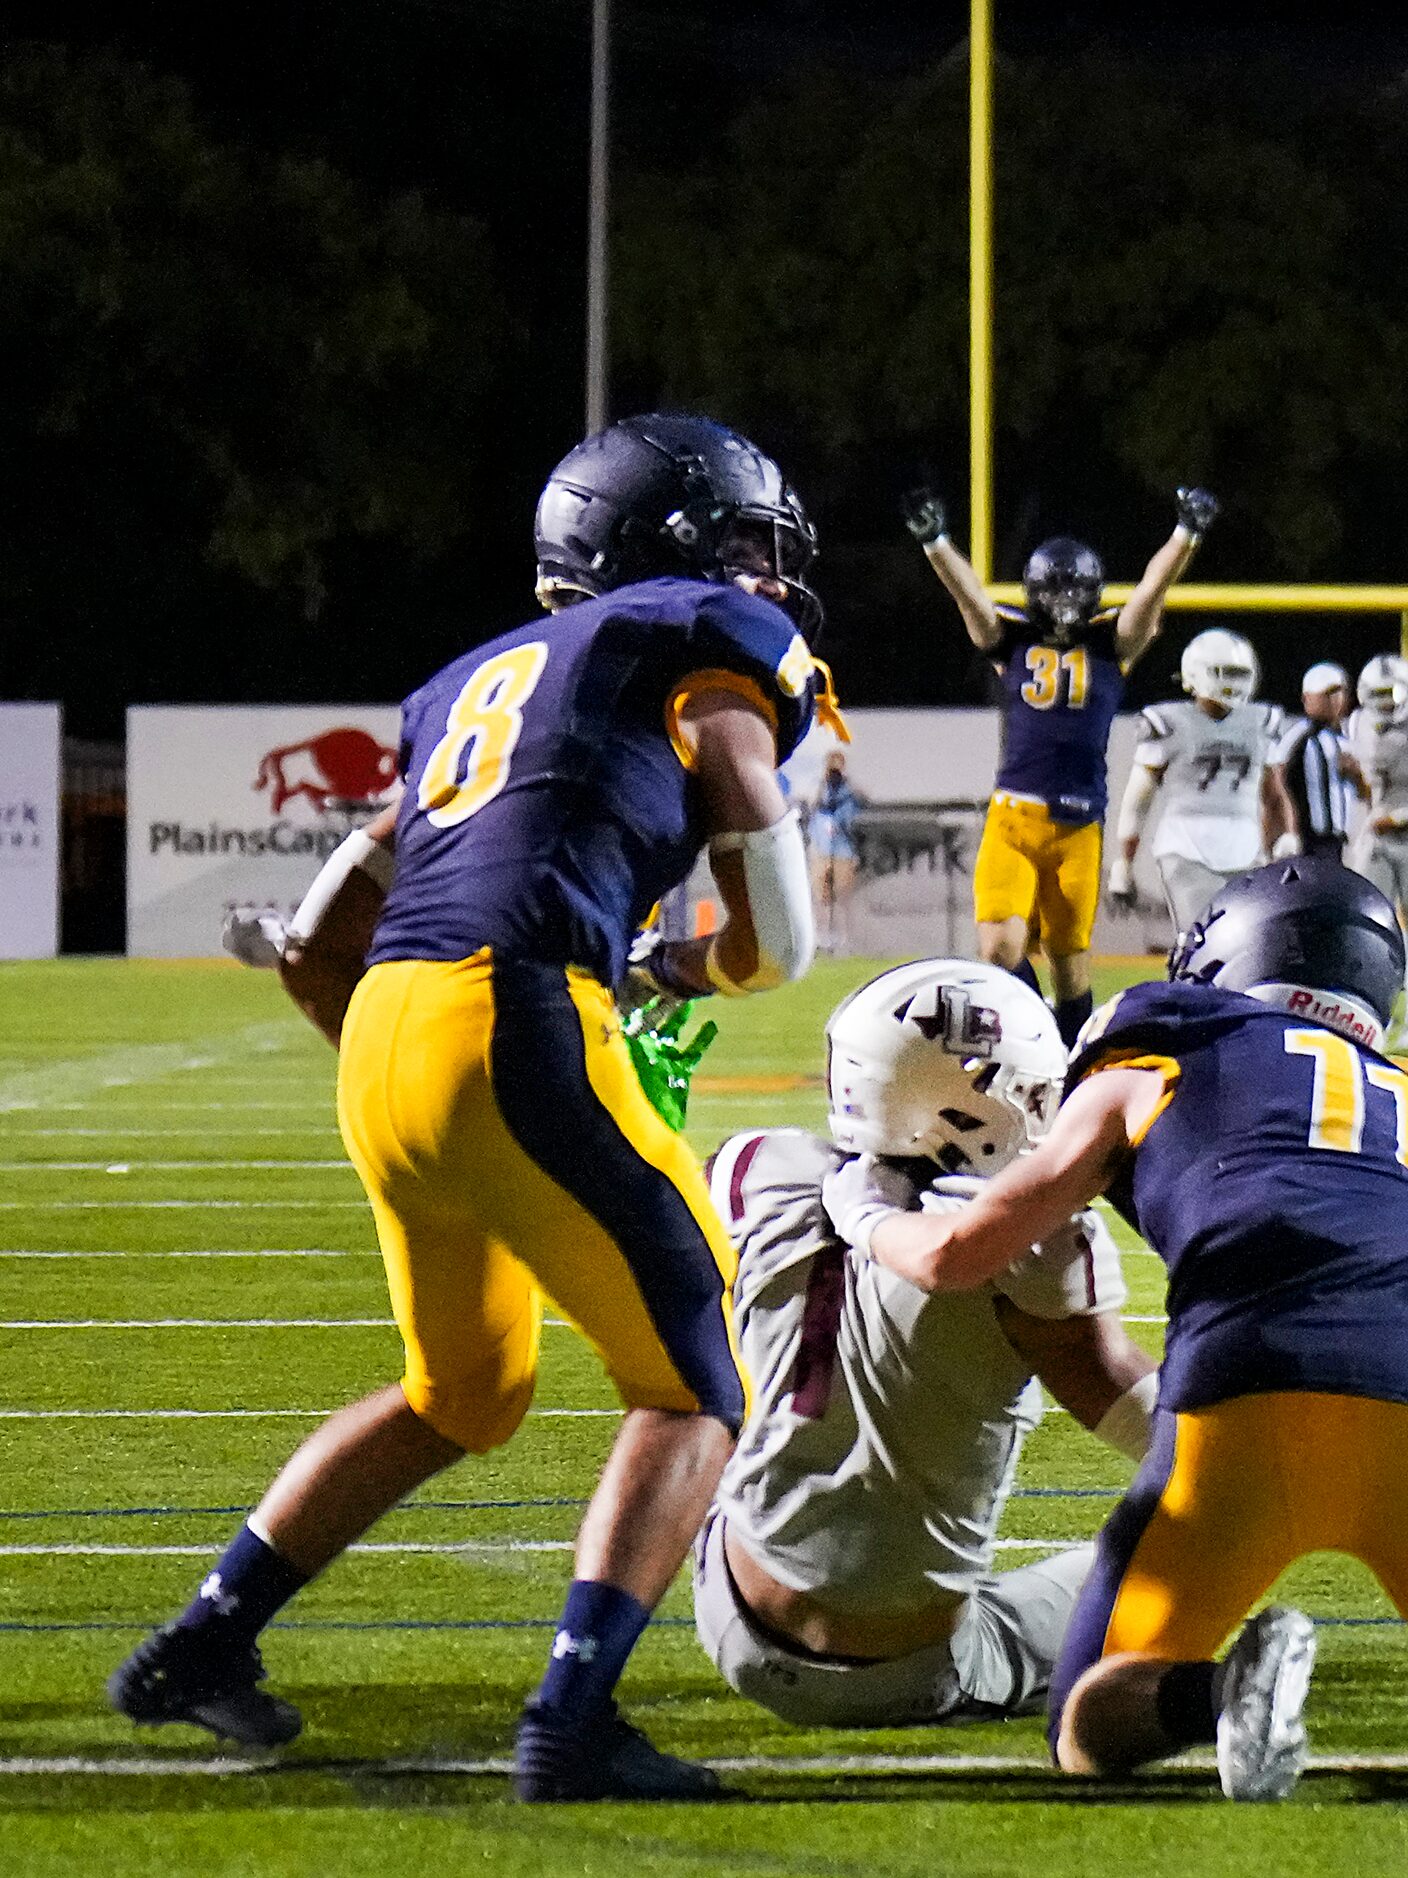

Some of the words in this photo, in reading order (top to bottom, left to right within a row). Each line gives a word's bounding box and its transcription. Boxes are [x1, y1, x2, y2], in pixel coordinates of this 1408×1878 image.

[1020, 645, 1086, 711] 31
[417, 640, 549, 829] 8
[1191, 754, 1251, 794] 77
[1286, 989, 1376, 1051] Riddell
